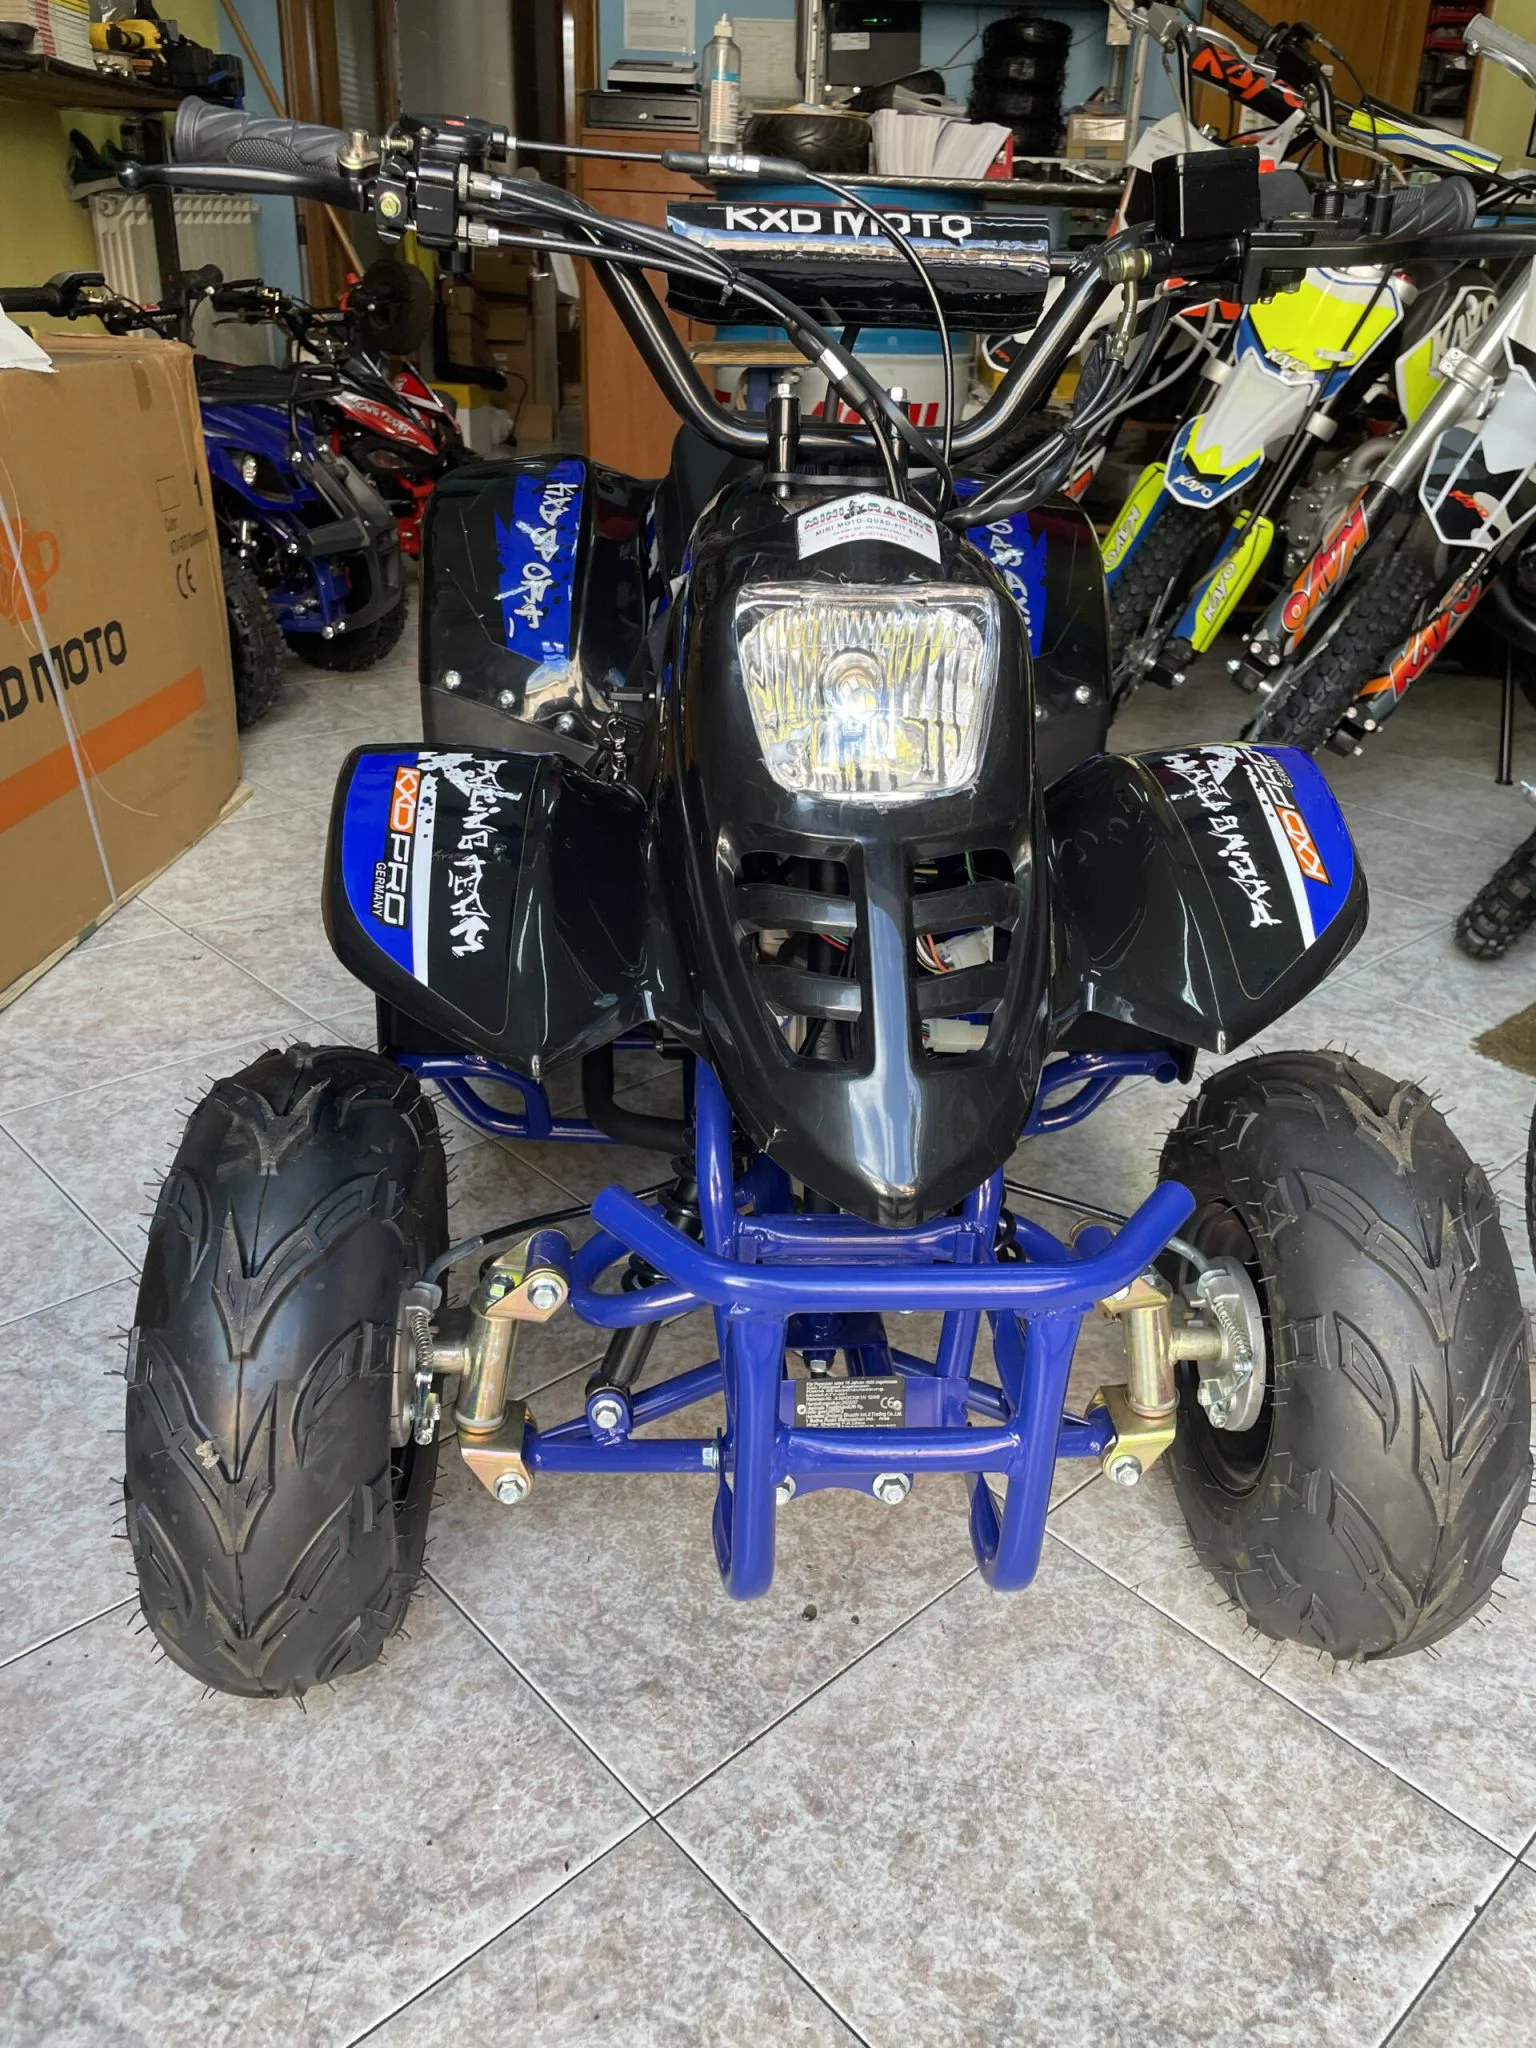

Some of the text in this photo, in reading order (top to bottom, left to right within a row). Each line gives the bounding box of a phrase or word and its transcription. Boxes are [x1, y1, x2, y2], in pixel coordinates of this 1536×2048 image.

[726, 206, 972, 240] KXD MOTO
[1281, 499, 1370, 633] KAYO
[29, 620, 127, 708] MOTO
[383, 769, 420, 926] KXD PRO
[1241, 748, 1328, 880] KXD PRO
[371, 862, 388, 917] GERMANY
